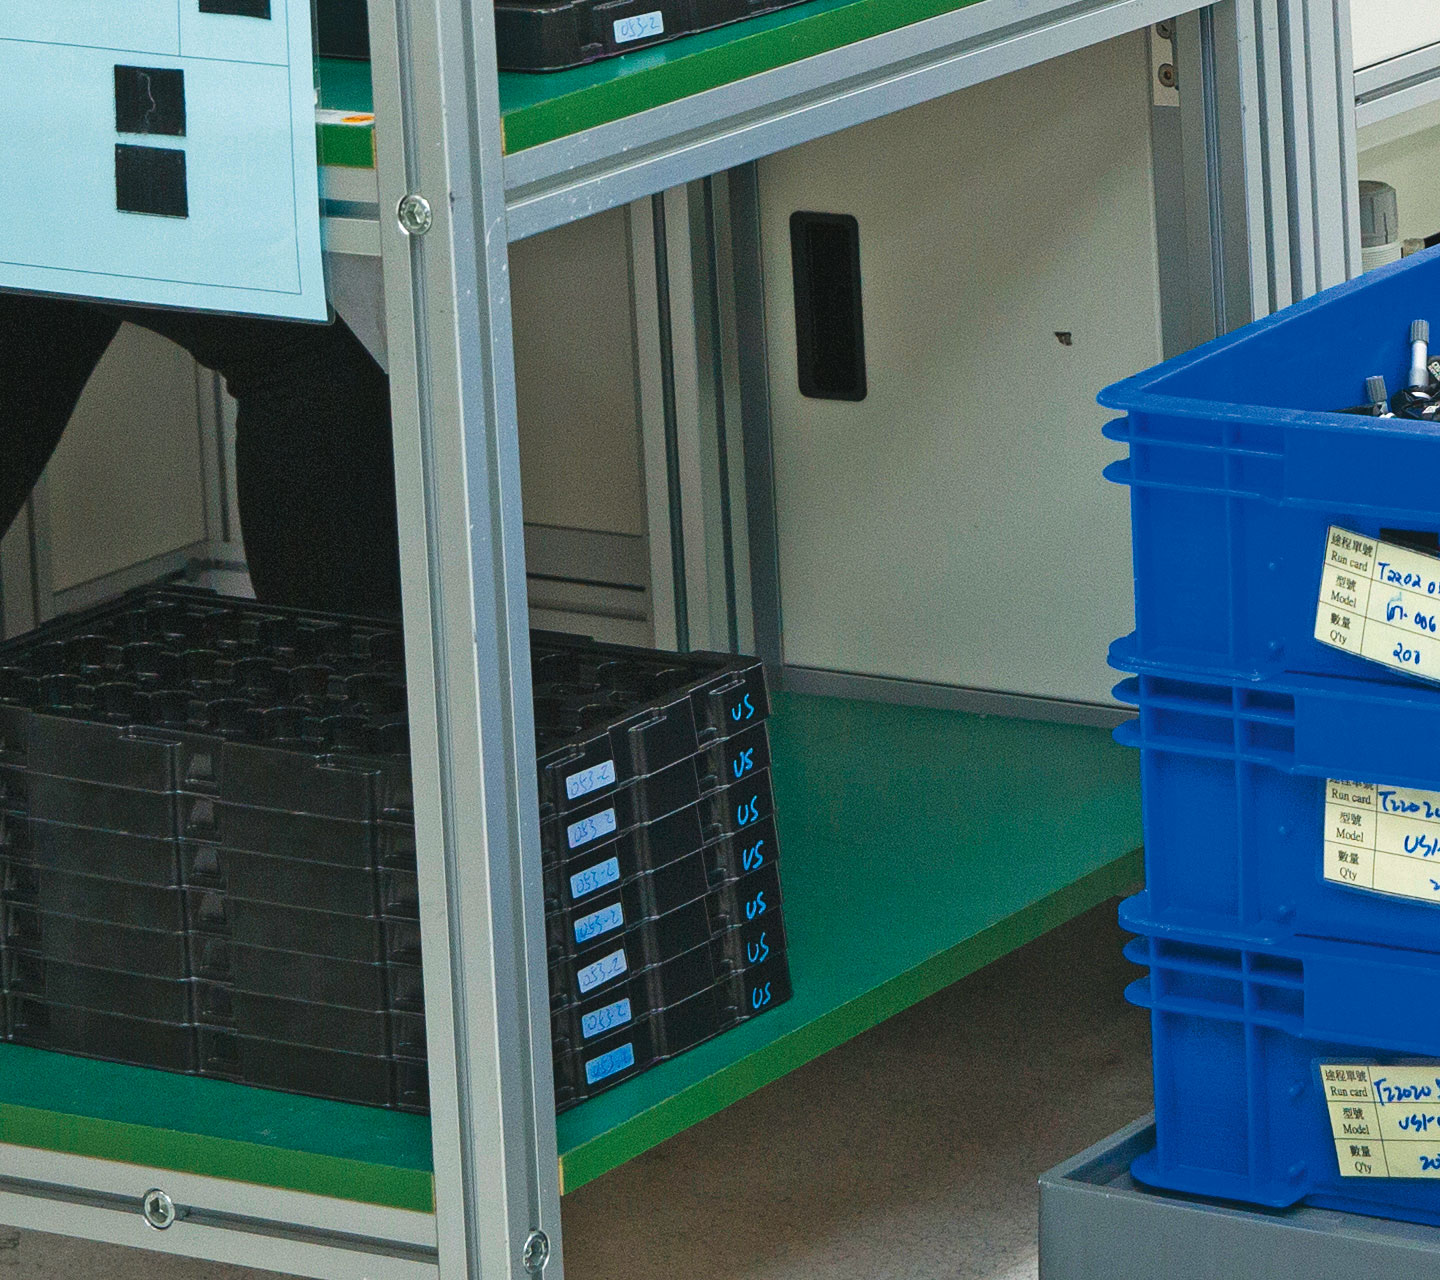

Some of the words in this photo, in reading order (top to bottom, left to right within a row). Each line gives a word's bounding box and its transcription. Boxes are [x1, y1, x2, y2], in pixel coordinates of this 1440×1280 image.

[620, 16, 661, 38] 053-2
[1330, 534, 1374, 558] 途程單號
[1330, 550, 1348, 564] Run
[1349, 558, 1368, 572] card
[1335, 575, 1357, 593] 型號
[1330, 590, 1357, 608] Model
[1330, 612, 1351, 630] 數量
[1329, 629, 1348, 646] Q'ty
[731, 693, 754, 722] US
[733, 748, 753, 779] US
[1331, 789, 1349, 800] Run
[1351, 793, 1371, 805] card
[737, 795, 759, 827] US
[1339, 811, 1362, 827] 型號
[1336, 827, 1364, 842] Model
[742, 840, 764, 871] US
[1338, 850, 1359, 865] 數量
[1339, 867, 1358, 881] Q'ty
[746, 891, 766, 920] US
[747, 931, 769, 965] US
[752, 982, 771, 1009] US
[1325, 1069, 1367, 1082] 途程單號
[1330, 1085, 1348, 1097] Run
[1349, 1085, 1368, 1097] card
[1343, 1107, 1365, 1120] 型號
[1343, 1123, 1370, 1135] Model
[1349, 1144, 1371, 1158] 數量
[1354, 1160, 1372, 1174] Q'ty
